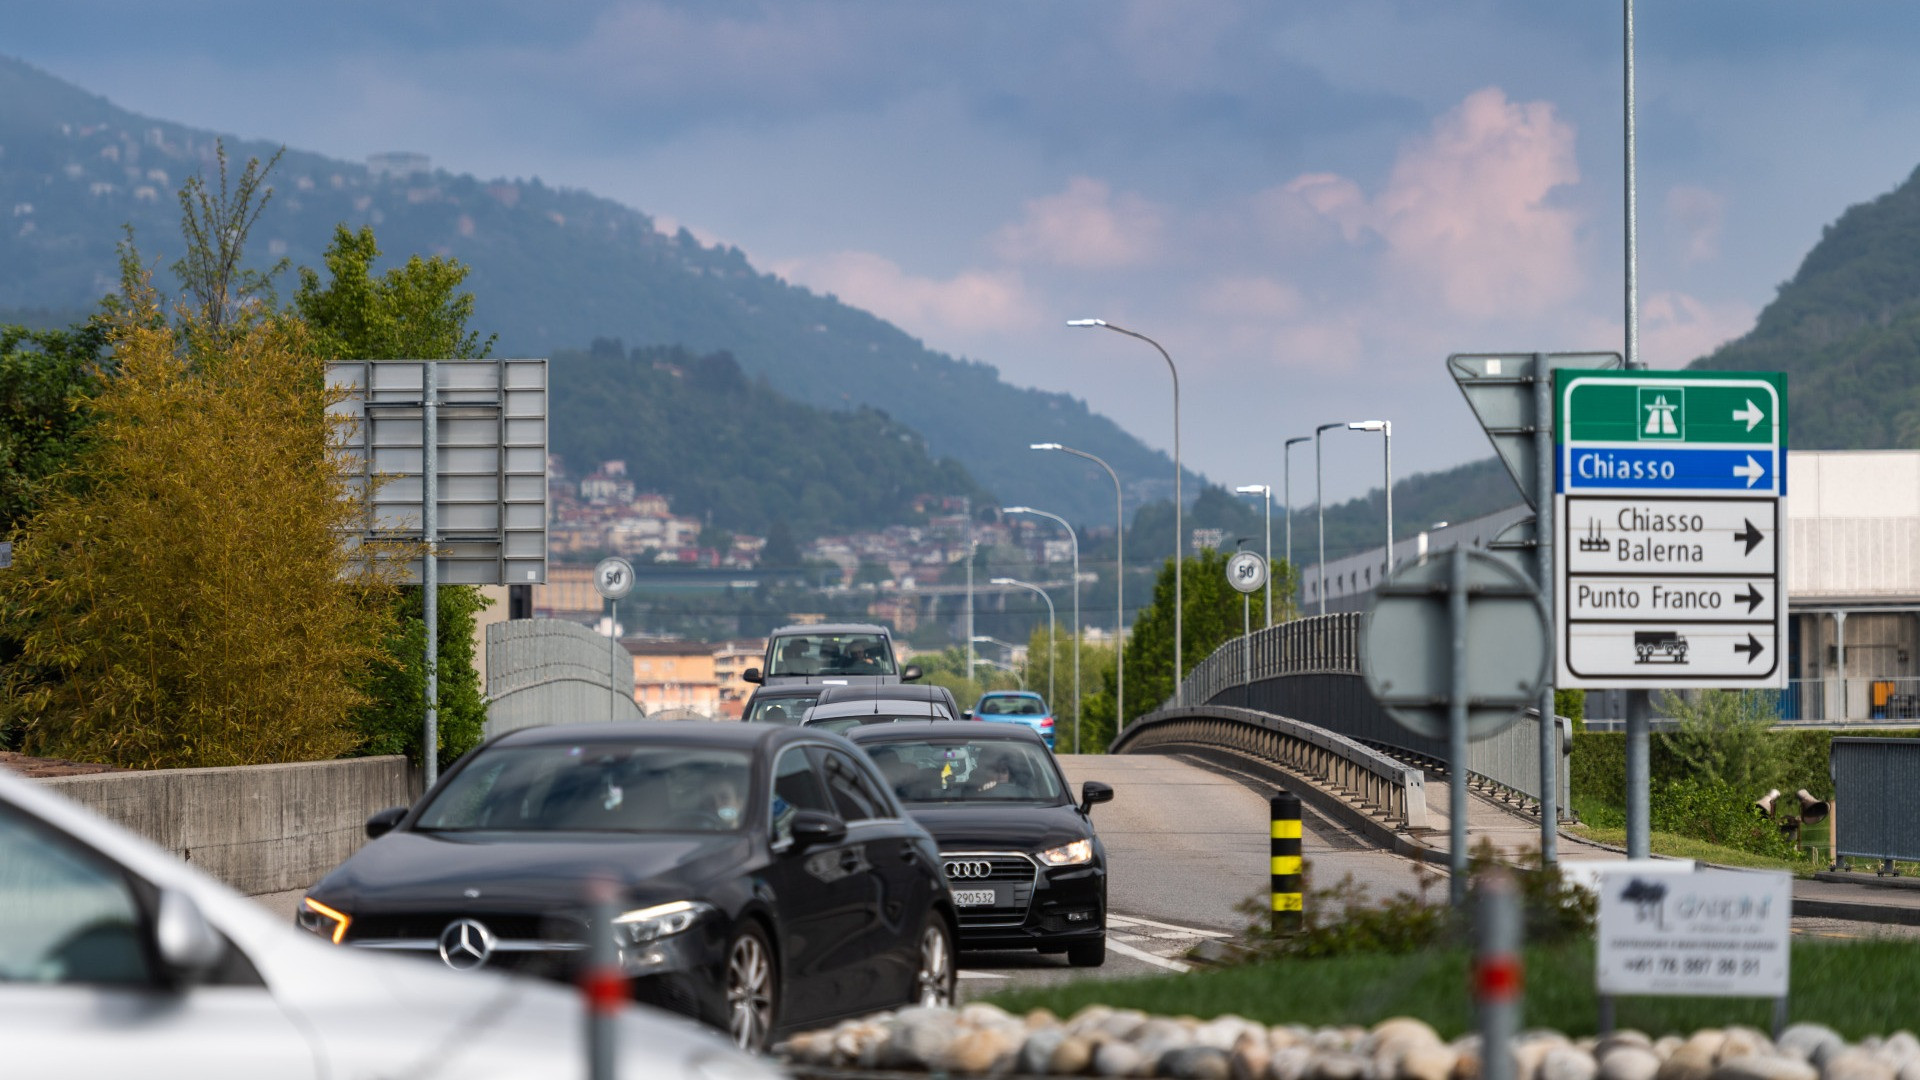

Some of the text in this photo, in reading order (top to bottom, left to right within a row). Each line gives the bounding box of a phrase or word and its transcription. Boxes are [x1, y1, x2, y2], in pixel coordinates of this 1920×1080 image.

[1578, 453, 1675, 479] Chiasso
[1617, 507, 1704, 532] Chiasso
[1617, 538, 1704, 562] Balerna
[606, 571, 620, 585] 50
[1239, 565, 1254, 578] 50
[1578, 585, 1722, 609] Punto Franco
